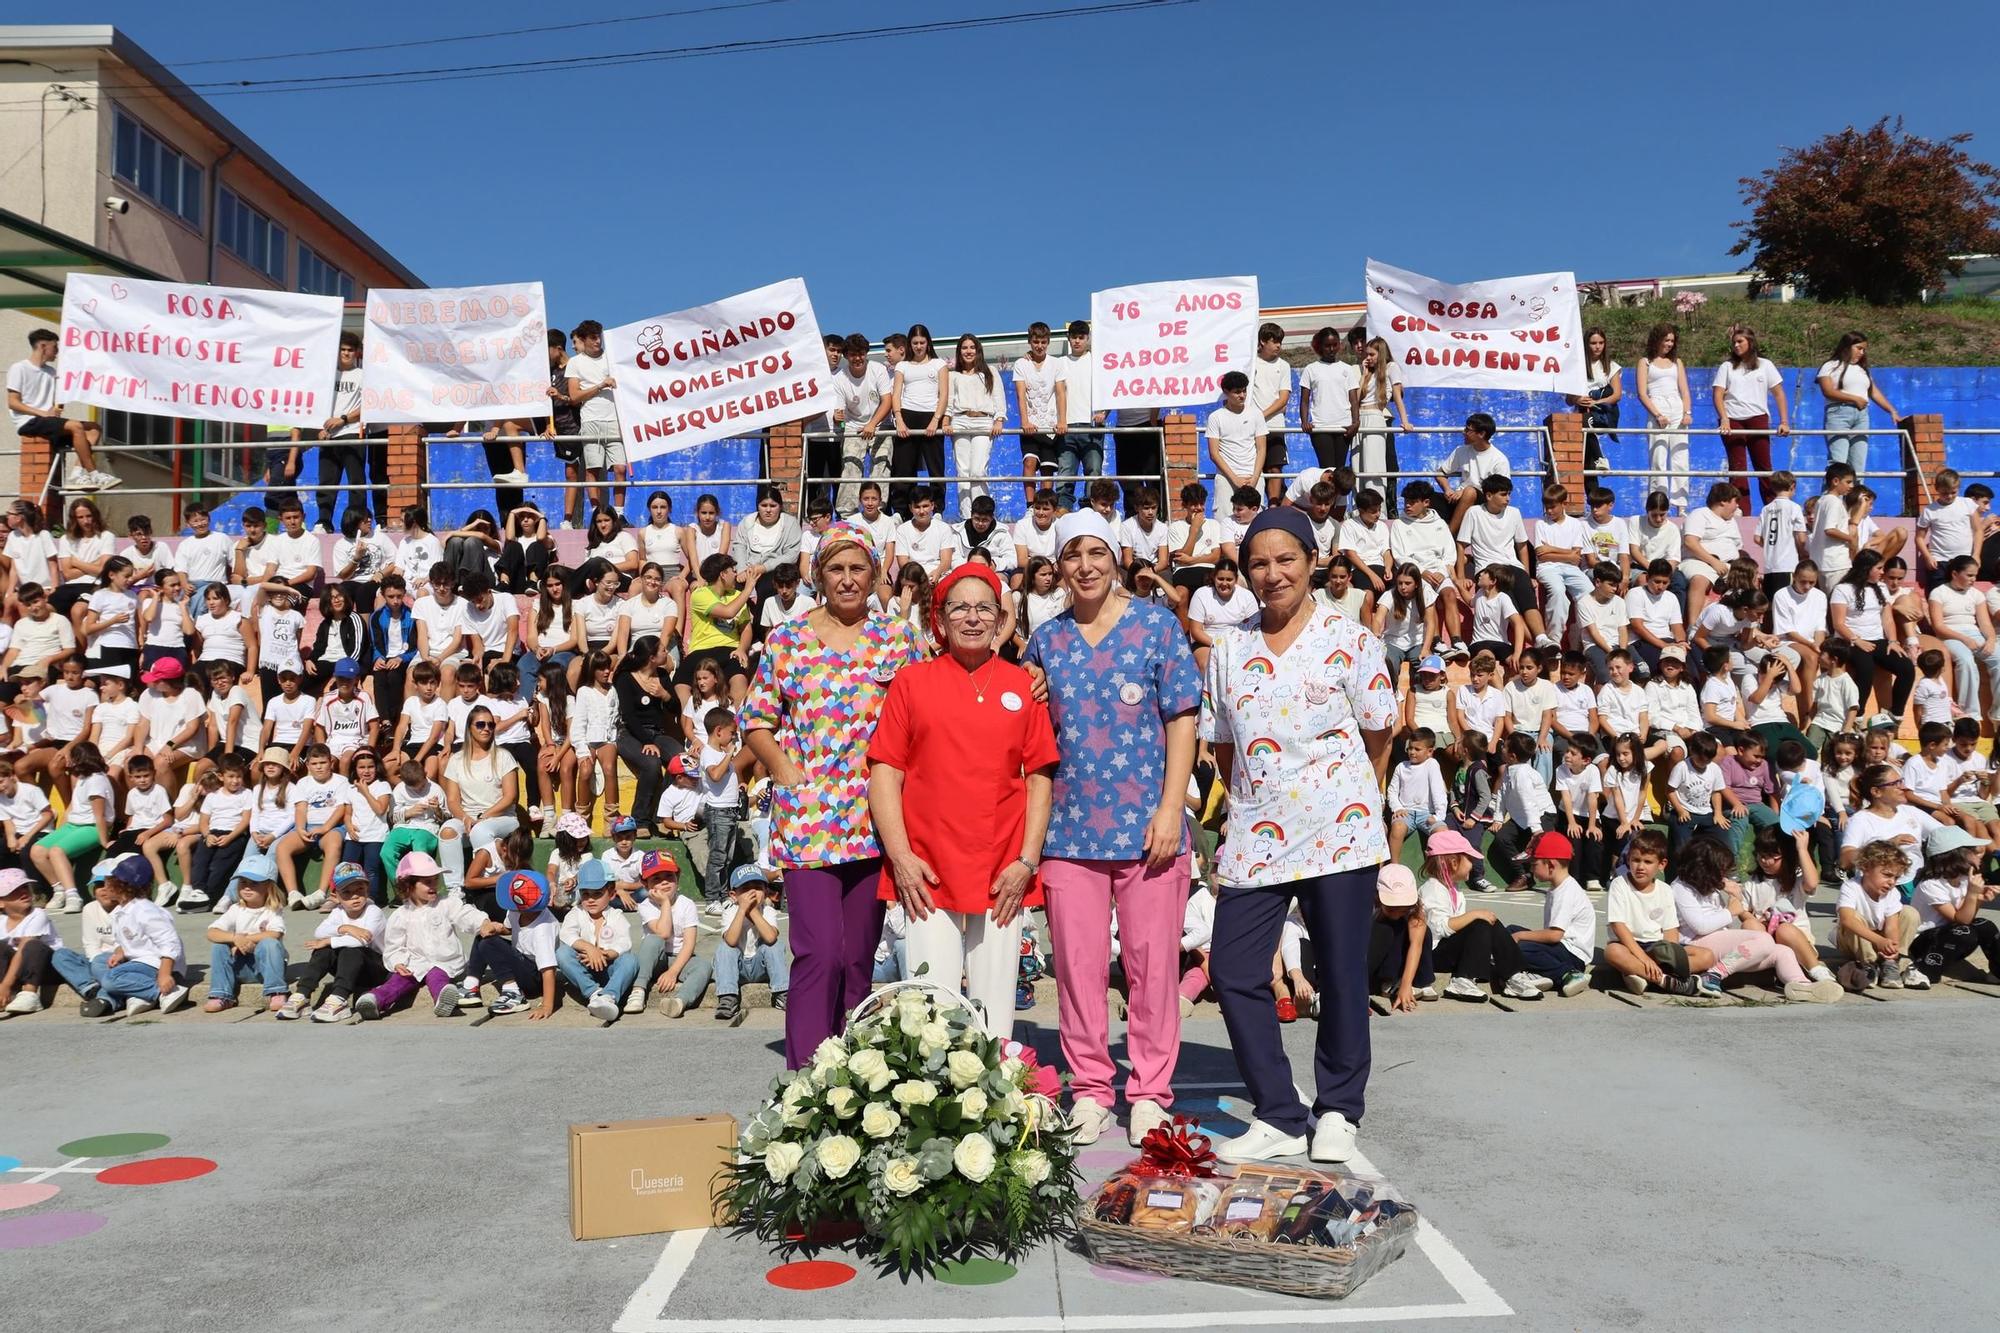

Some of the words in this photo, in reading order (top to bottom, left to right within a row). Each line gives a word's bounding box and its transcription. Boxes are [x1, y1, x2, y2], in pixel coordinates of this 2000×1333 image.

[167, 293, 242, 321] ROSA,
[371, 295, 531, 325] QUEREMOS
[1112, 302, 1141, 321] 46
[1175, 292, 1242, 312] ANOS
[1428, 299, 1498, 319] ROSA
[636, 311, 796, 370] COCIÑANDO
[1158, 319, 1189, 337] DE
[1510, 326, 1561, 344] QUE
[65, 324, 242, 364] BOTARÉMOSTE
[273, 346, 306, 369] DE
[369, 343, 388, 363] A
[406, 336, 528, 366] RECEITA
[1103, 346, 1189, 371] SABOR
[1215, 343, 1229, 364] E
[1405, 346, 1561, 373] ALIMENTA
[647, 351, 794, 405] MOMENTOS
[1112, 375, 1226, 398] AGARIM
[363, 387, 414, 411] DAS
[633, 379, 819, 443] INESQUECIBLES
[1768, 517, 1779, 546] 9
[333, 720, 359, 731] bwin
